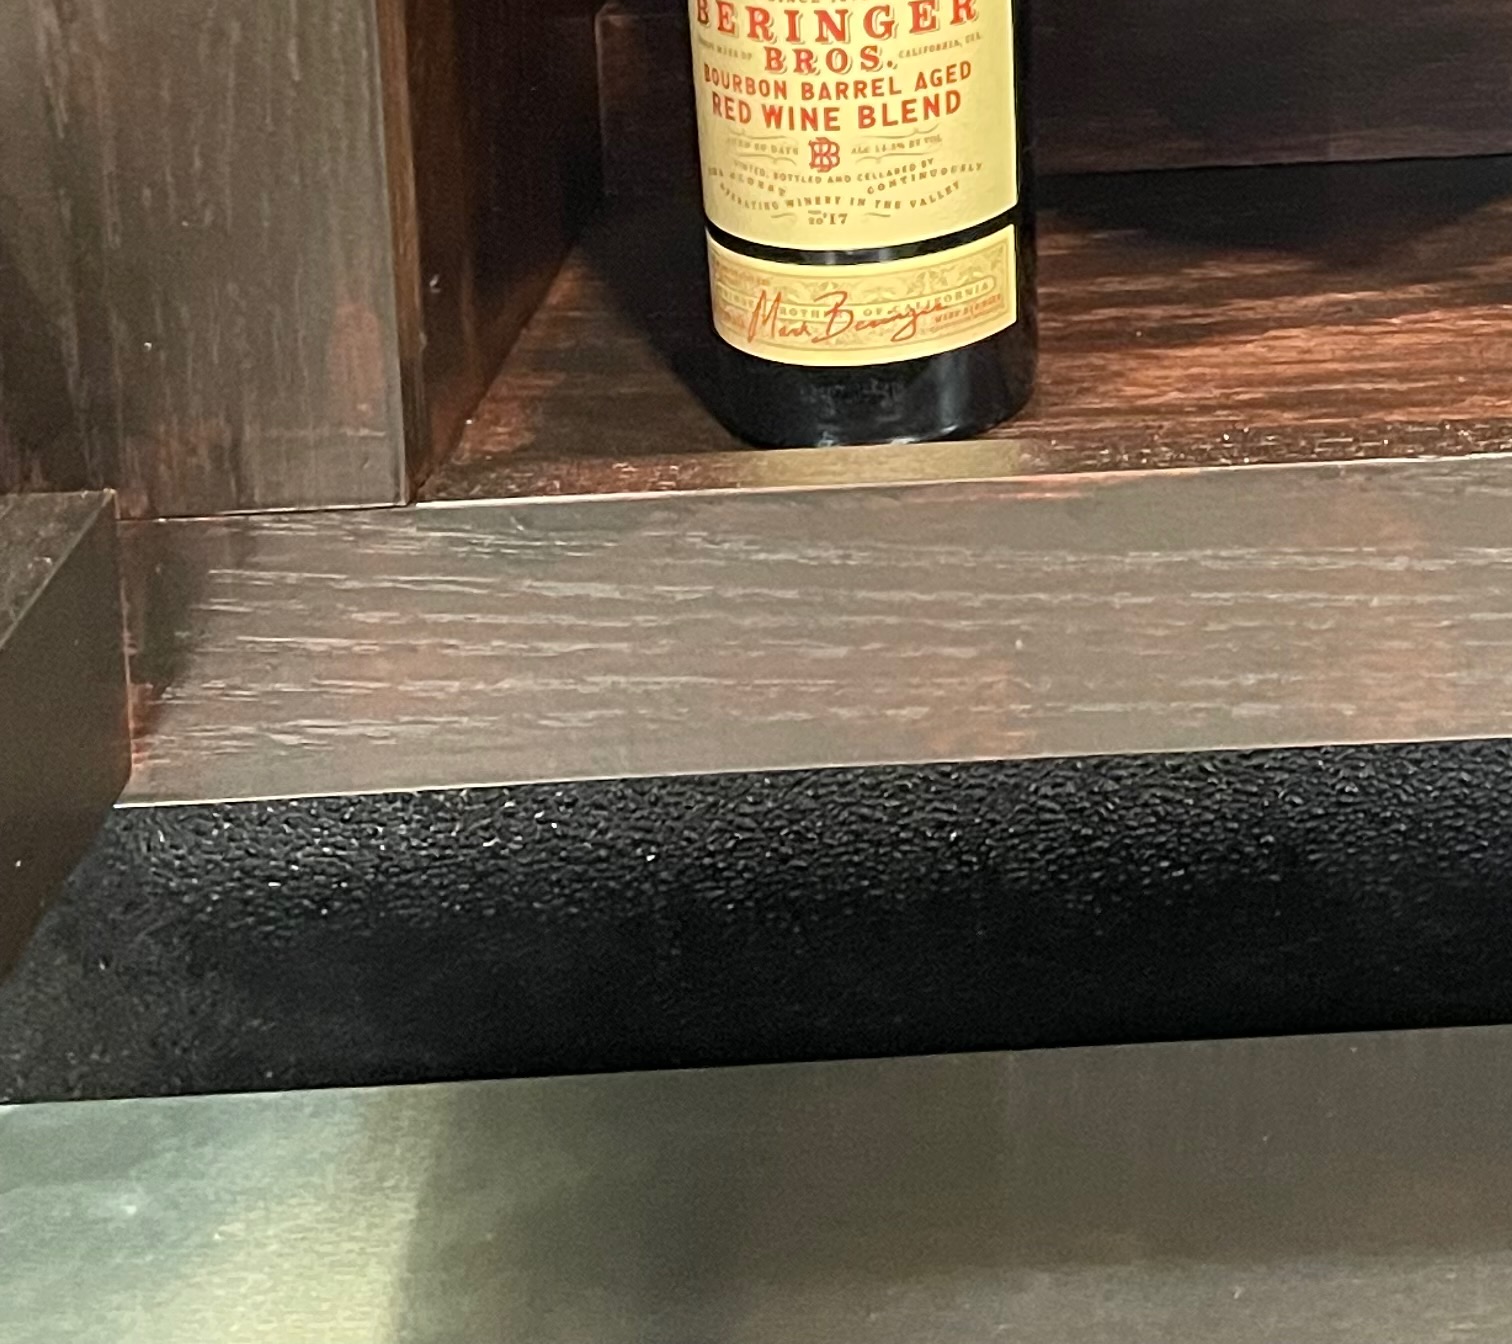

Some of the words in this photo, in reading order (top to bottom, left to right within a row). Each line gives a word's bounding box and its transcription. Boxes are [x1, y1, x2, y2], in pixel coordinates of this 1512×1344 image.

[763, 44, 897, 75] BROS.
[704, 62, 787, 100] BOURBON
[801, 76, 902, 101] BARREL
[914, 60, 971, 91] AGED
[712, 91, 751, 124] RED
[761, 102, 840, 131] WINE
[857, 89, 961, 129] BLEND
[773, 171, 822, 184] BOTTLED
[827, 175, 851, 184] AND
[921, 158, 934, 169] BY
[850, 197, 866, 207] IN
[875, 199, 901, 210] THE
[910, 180, 960, 208] VALLEY
